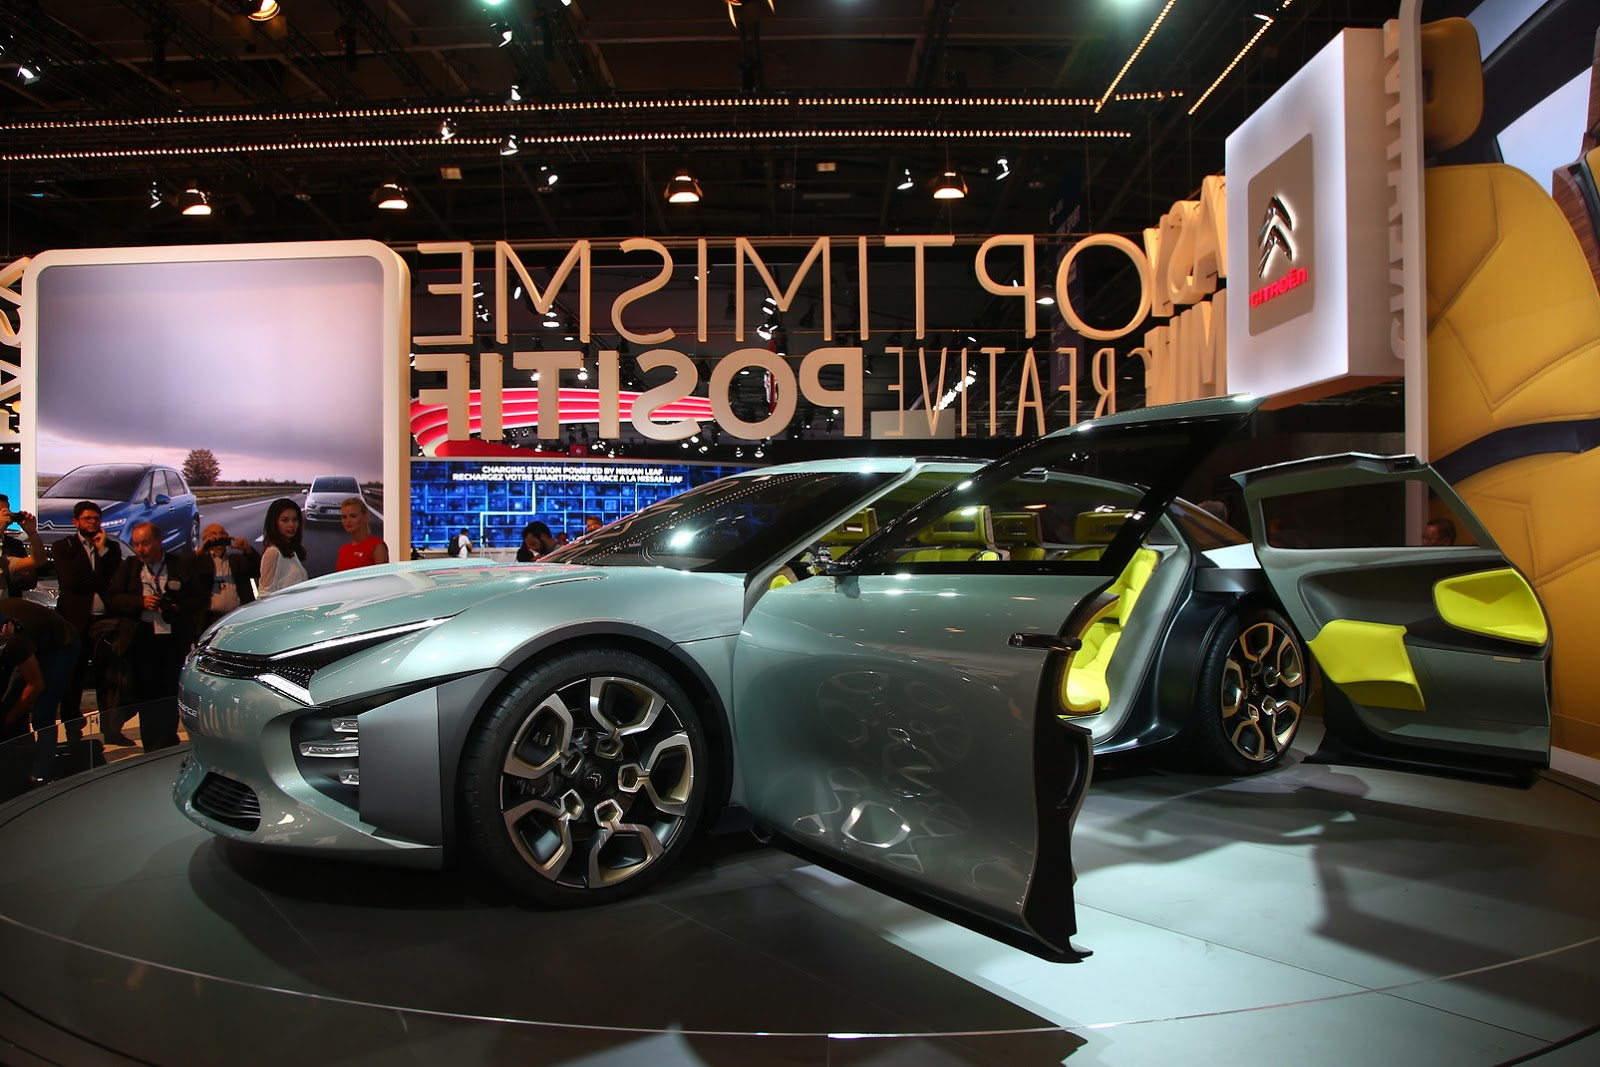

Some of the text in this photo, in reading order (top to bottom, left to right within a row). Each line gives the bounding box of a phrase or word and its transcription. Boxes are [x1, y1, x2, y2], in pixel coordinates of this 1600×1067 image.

[482, 466, 526, 474] CHARGING
[563, 467, 603, 475] POWERED
[603, 467, 615, 475] BY
[452, 473, 504, 481] RECHARGEZ
[533, 474, 591, 482] SMARTPHONE
